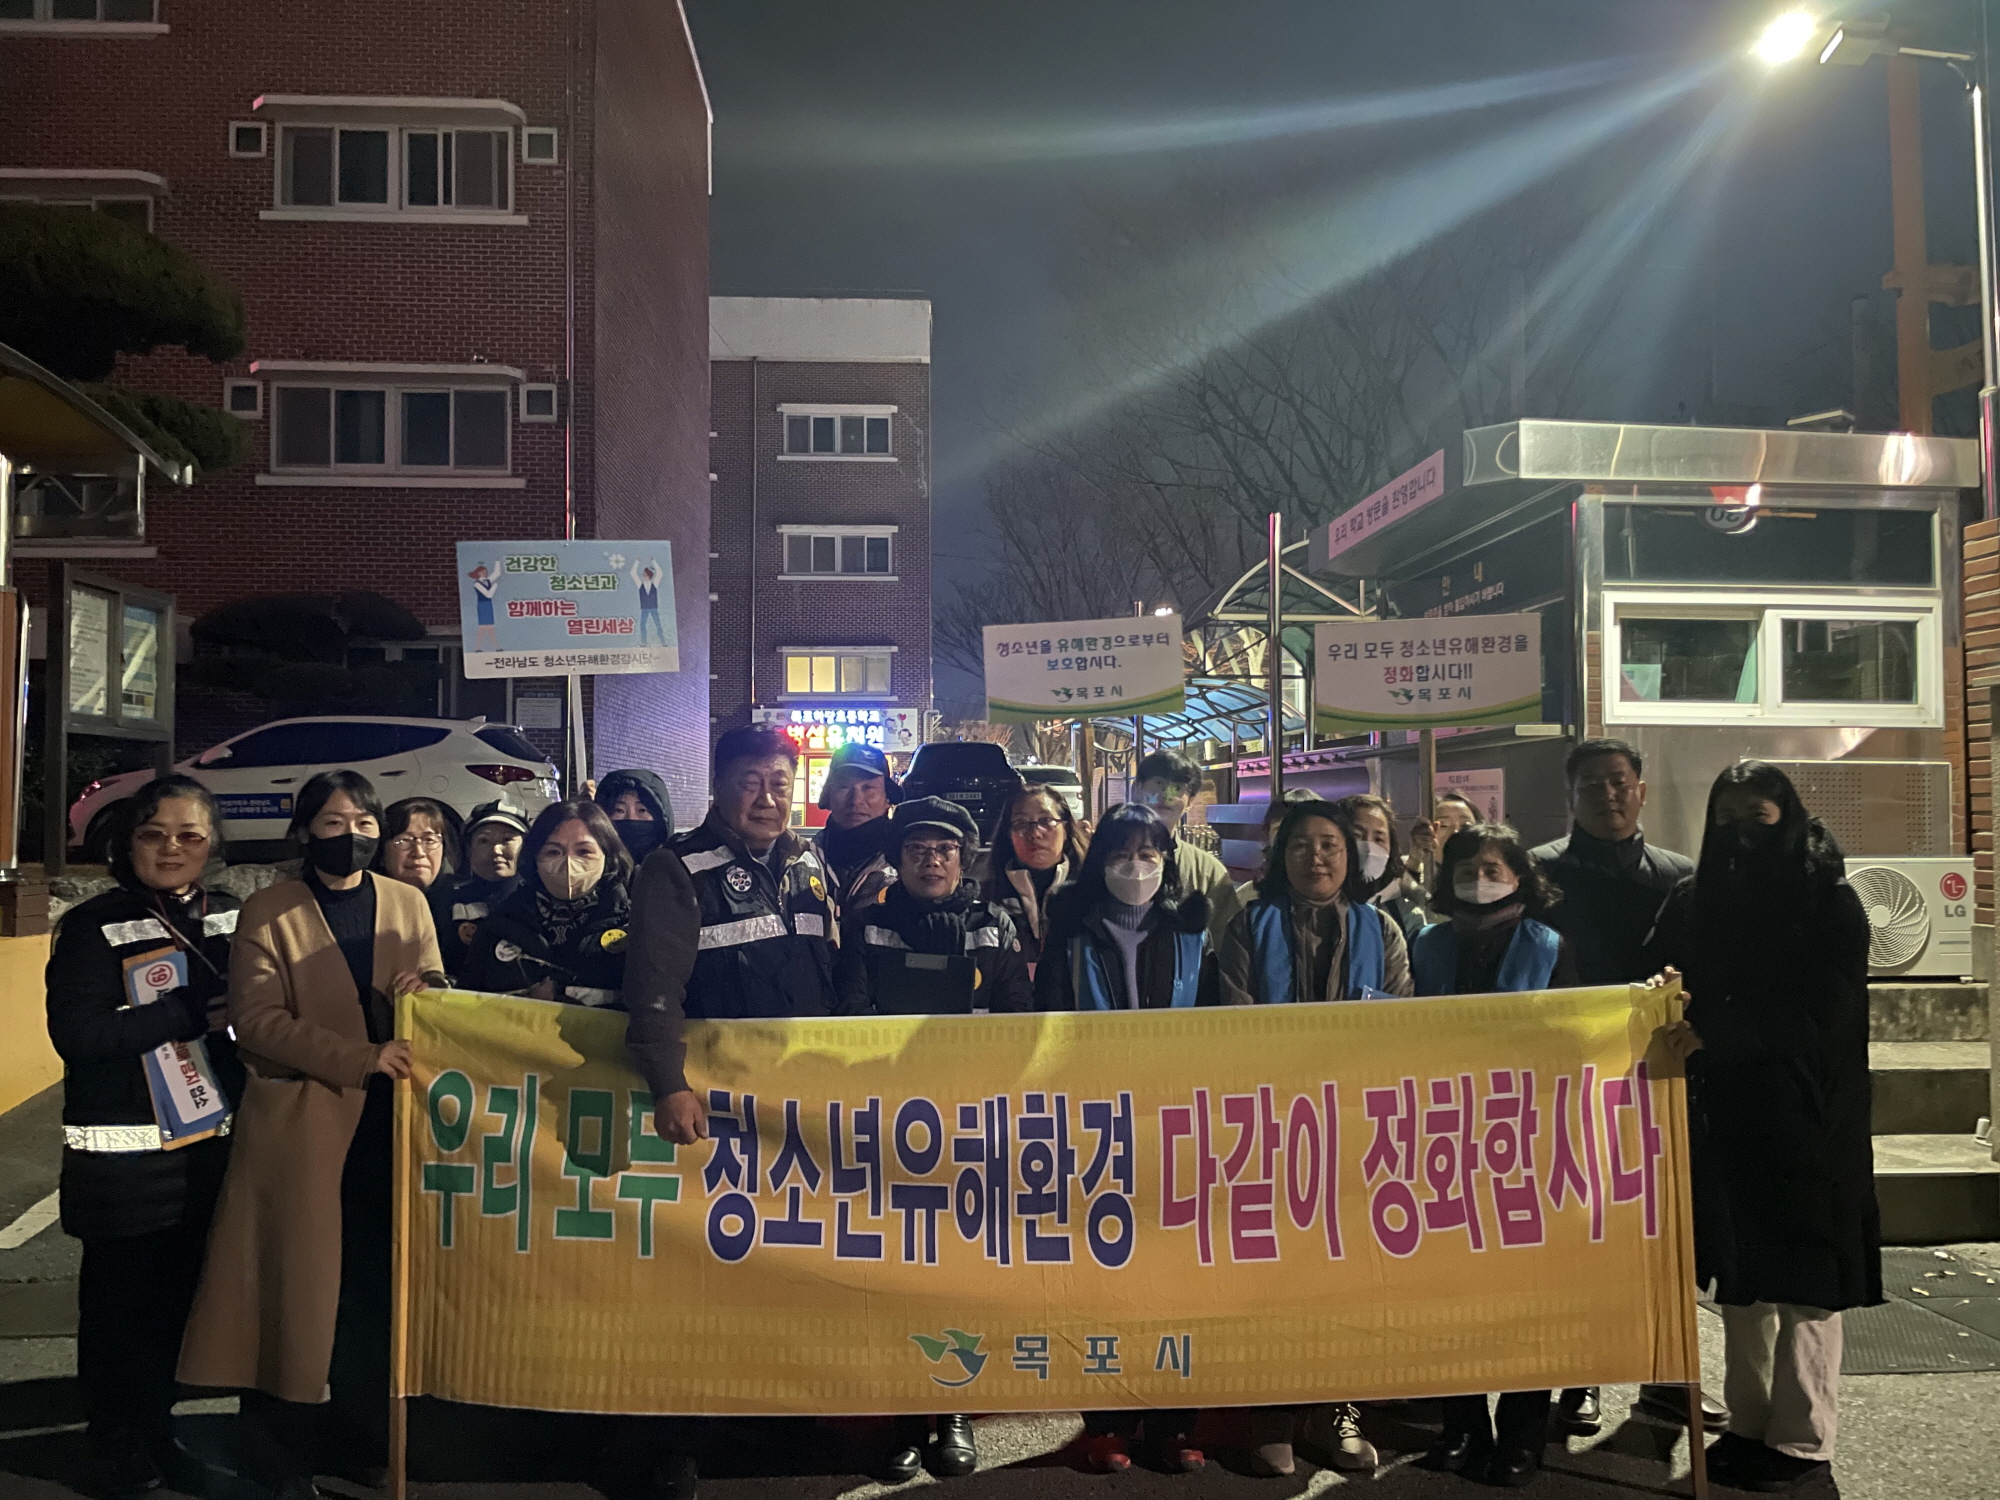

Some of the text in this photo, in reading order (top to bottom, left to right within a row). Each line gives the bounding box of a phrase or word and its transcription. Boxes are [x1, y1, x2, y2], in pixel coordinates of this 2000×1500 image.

[1334, 523, 1348, 545] 우리
[1392, 466, 1436, 511] 환영합니다
[505, 555, 557, 573] 건강한
[549, 574, 618, 591] 청소년과
[507, 600, 577, 617] 함께하는
[567, 618, 635, 635] 열린세상
[996, 632, 1170, 658] 청소년을 유해환경으로부터
[1328, 634, 1528, 661] 우리 모두 청소년유해환경을
[1047, 655, 1122, 671] 보호합시다.
[1383, 662, 1473, 684] 정화합시다!!
[1944, 905, 1966, 917] LG
[151, 966, 169, 983] 19
[180, 1060, 202, 1086] 금지
[189, 1085, 209, 1110] 업소
[421, 1059, 1665, 1270] 우리 모두 청소년유해환경 다같이 정화합시다
